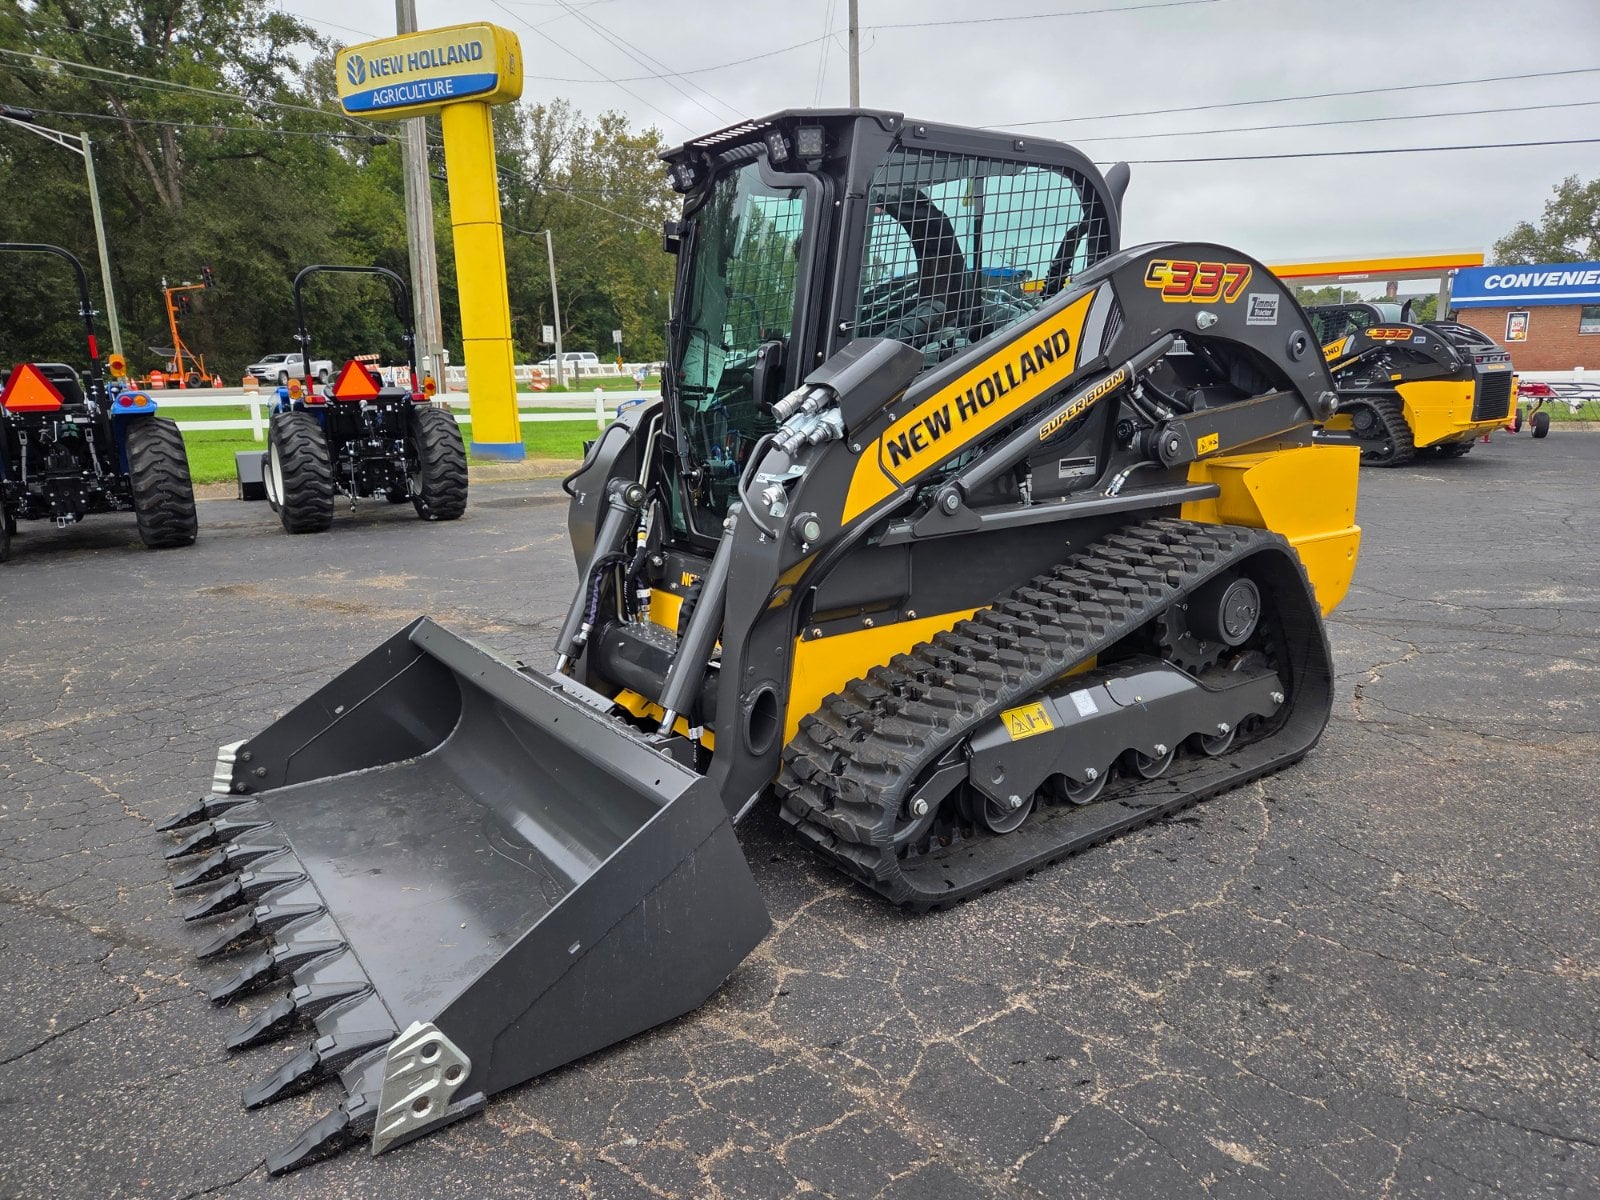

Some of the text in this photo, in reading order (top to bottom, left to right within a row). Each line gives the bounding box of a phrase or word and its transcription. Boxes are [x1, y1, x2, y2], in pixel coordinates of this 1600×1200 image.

[369, 54, 403, 78] NEW
[407, 41, 482, 71] HOLLAND
[372, 79, 453, 105] AGRICULTURE
[1484, 270, 1600, 290] CONVENIE
[886, 328, 1070, 468] NEW HOLLAND
[681, 571, 700, 587] NE
